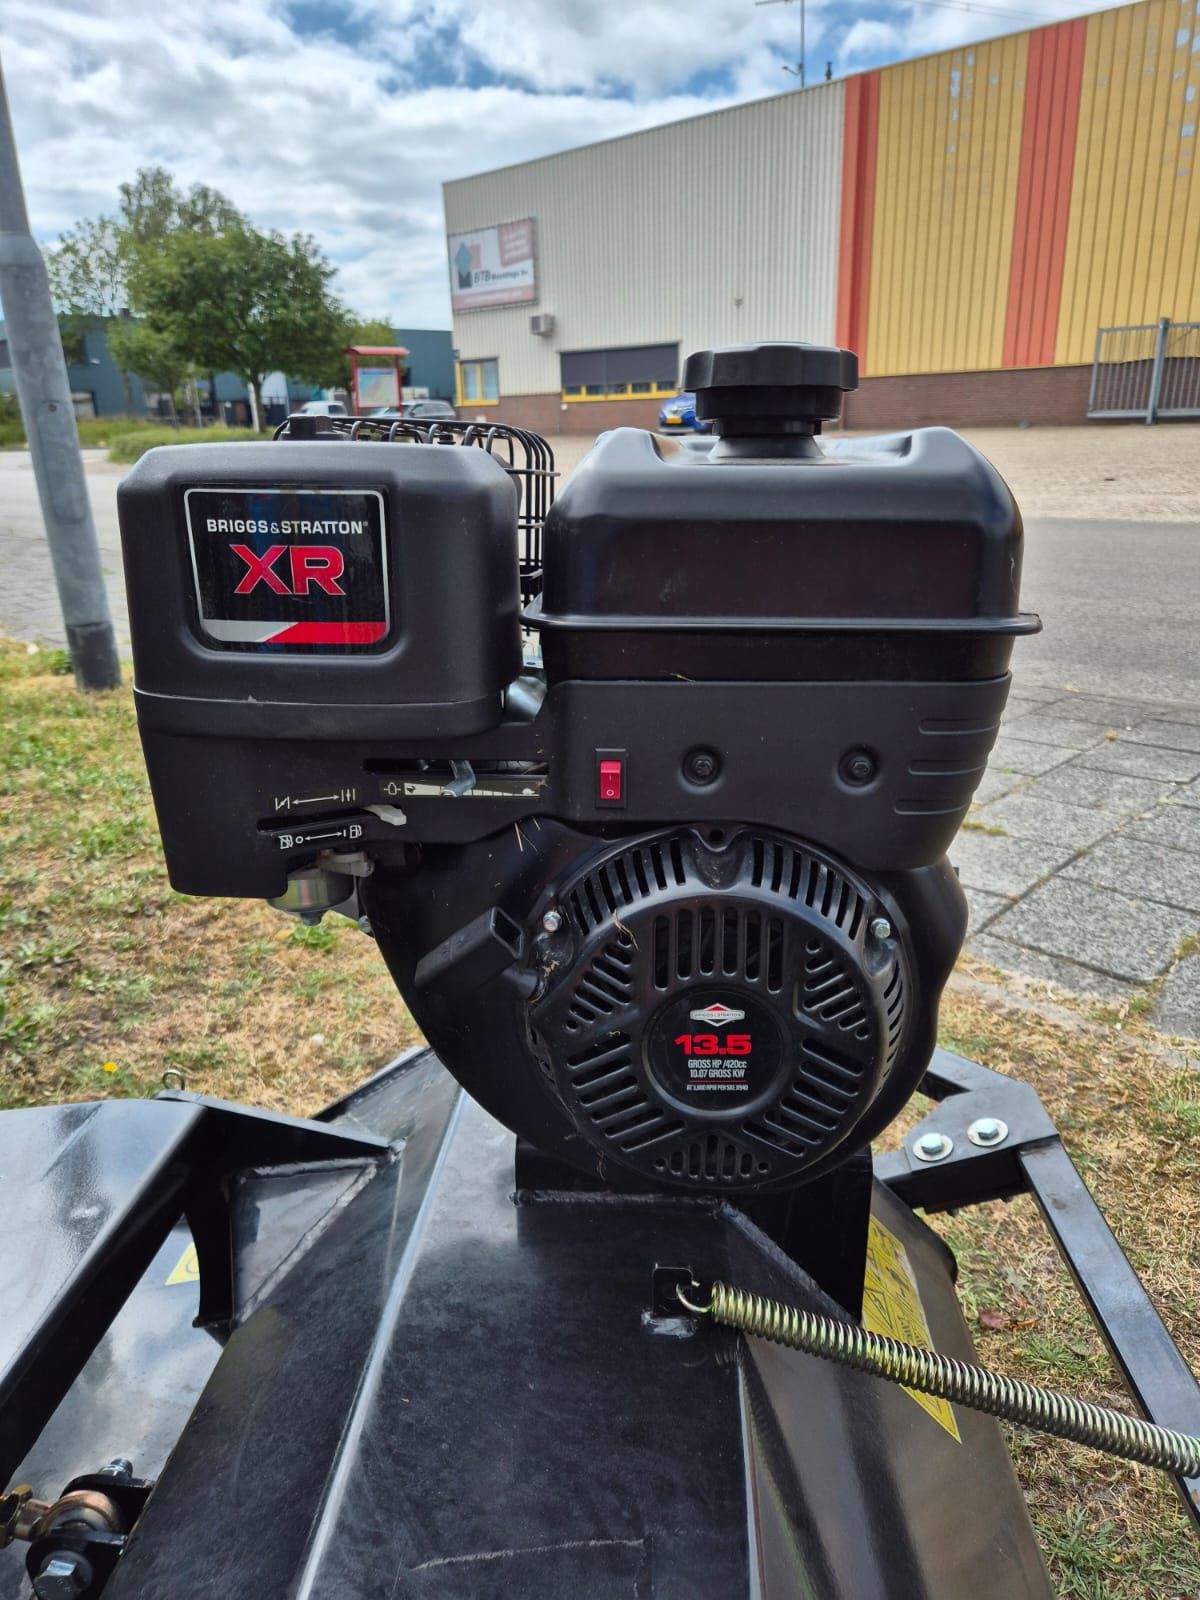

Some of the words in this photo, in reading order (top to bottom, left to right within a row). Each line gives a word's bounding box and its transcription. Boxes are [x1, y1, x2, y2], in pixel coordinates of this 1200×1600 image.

[229, 544, 347, 596] XR
[674, 1034, 752, 1055] 13.5
[687, 1059, 711, 1069] GROSS
[712, 1059, 722, 1069] HP
[689, 1069, 707, 1078] 10.07
[708, 1069, 732, 1078] GROSS
[733, 1069, 745, 1078] KW
